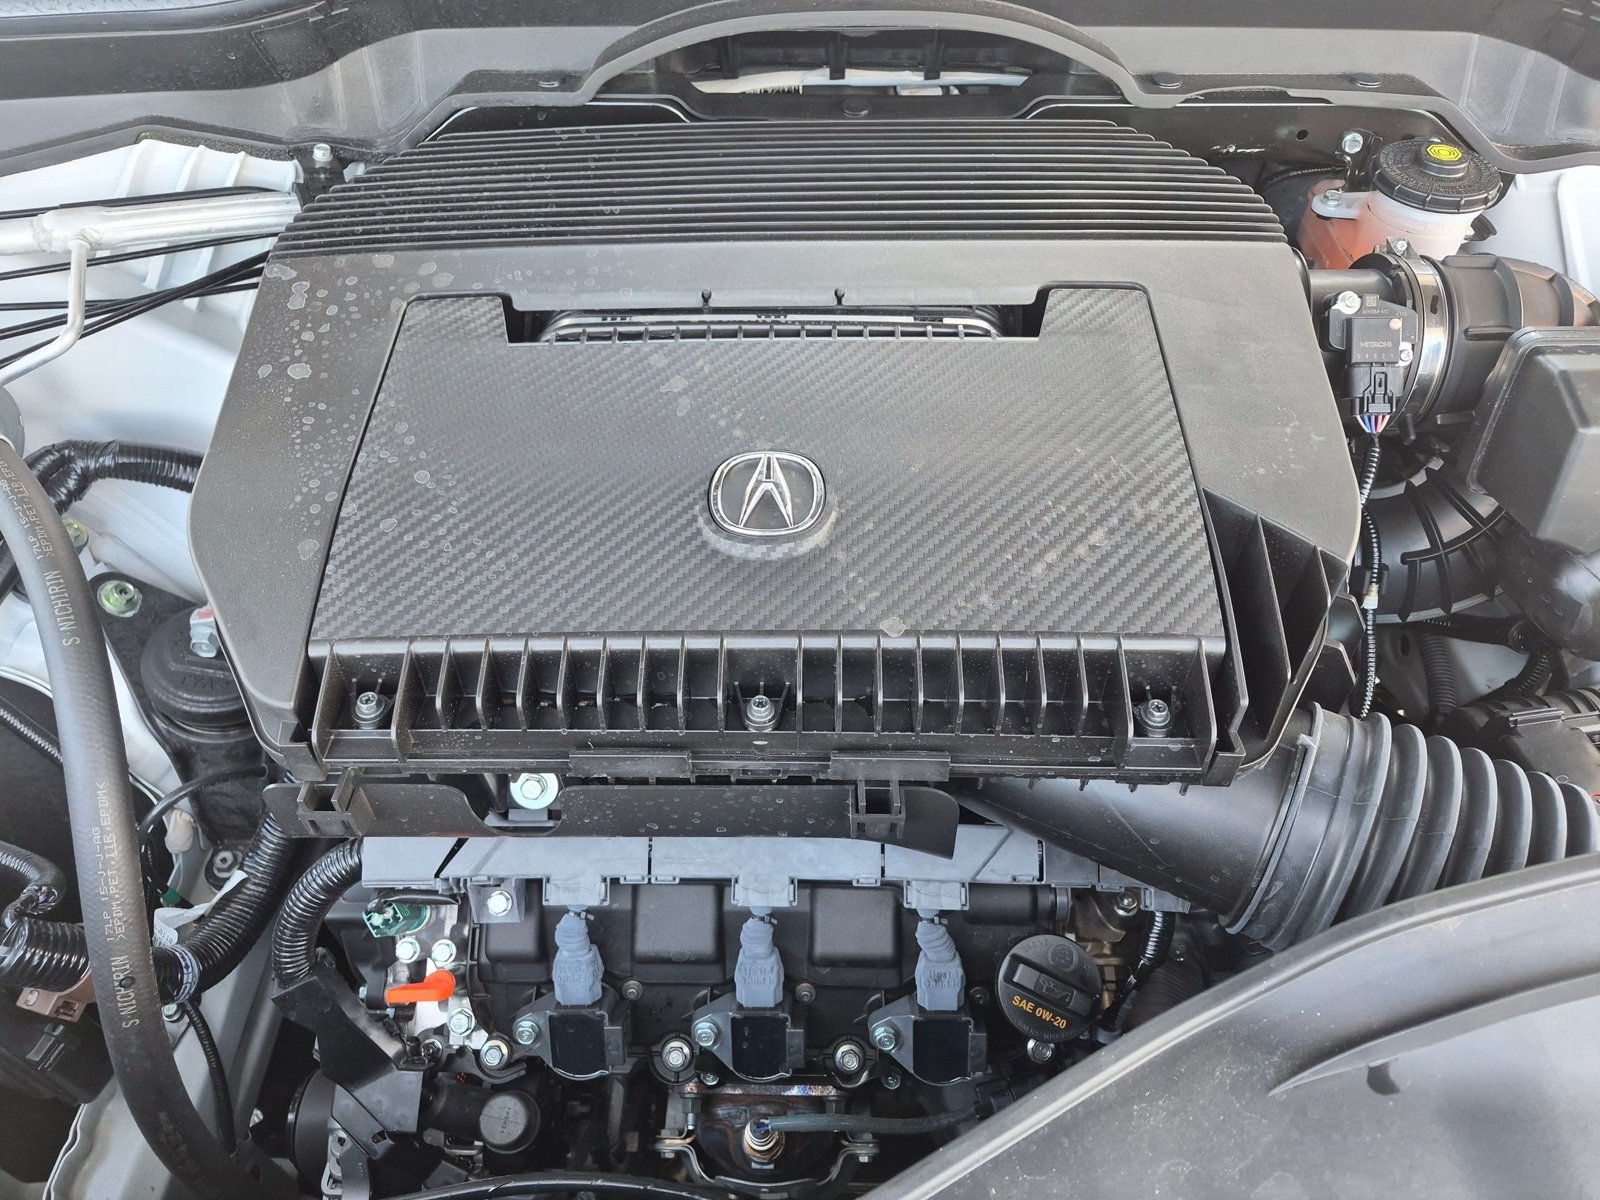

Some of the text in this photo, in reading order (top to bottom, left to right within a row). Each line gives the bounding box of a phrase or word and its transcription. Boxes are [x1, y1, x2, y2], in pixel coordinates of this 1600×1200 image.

[28, 535, 44, 560] 17LP
[102, 911, 115, 941] 17LP
[1012, 995, 1035, 1013] SAE
[1035, 1007, 1067, 1029] 0W-20
